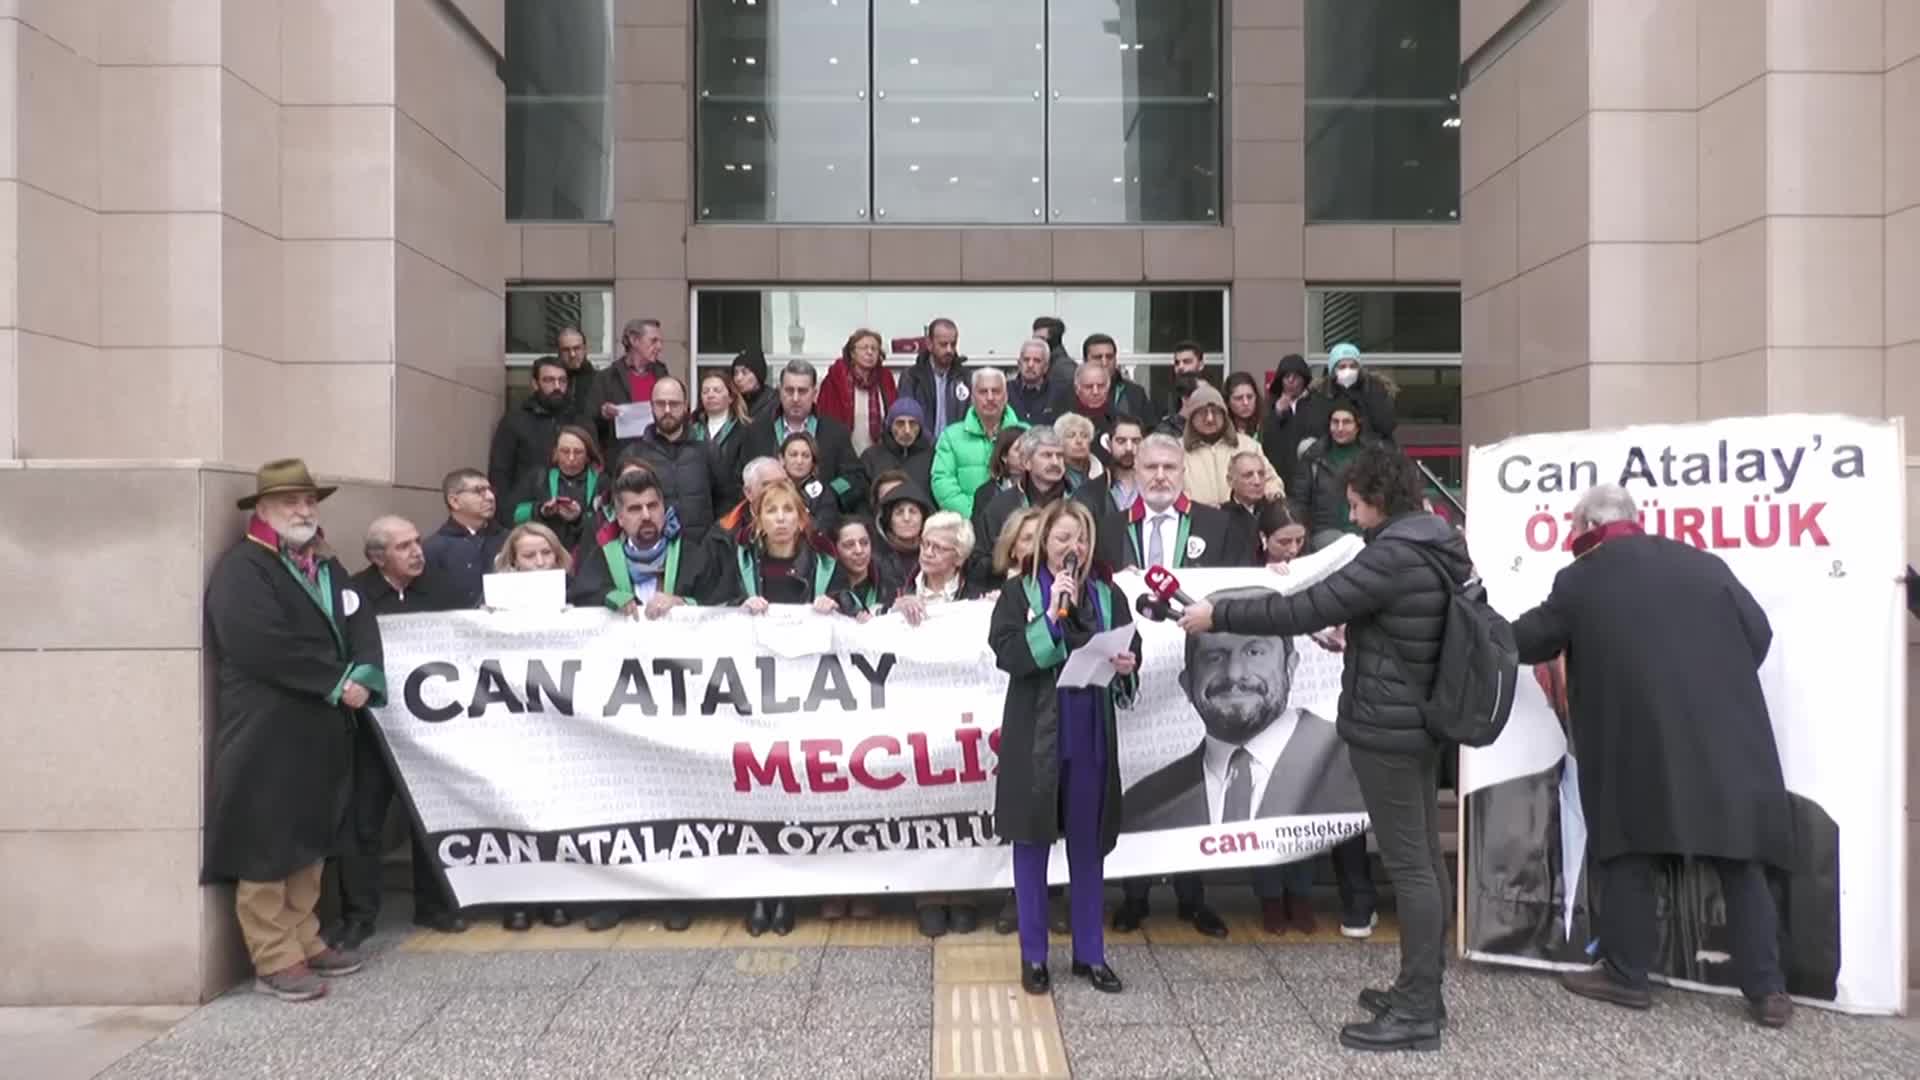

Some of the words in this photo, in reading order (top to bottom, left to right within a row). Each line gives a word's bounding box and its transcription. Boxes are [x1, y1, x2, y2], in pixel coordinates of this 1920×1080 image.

[1497, 454, 1598, 495] Can
[1617, 435, 1865, 494] Atalay'a
[403, 658, 582, 723] CAN
[602, 653, 896, 718] ATALAY
[438, 832, 539, 867] CAN
[554, 823, 769, 866] ATALAY'A
[778, 811, 1003, 856] ÖZGÜRLÜ
